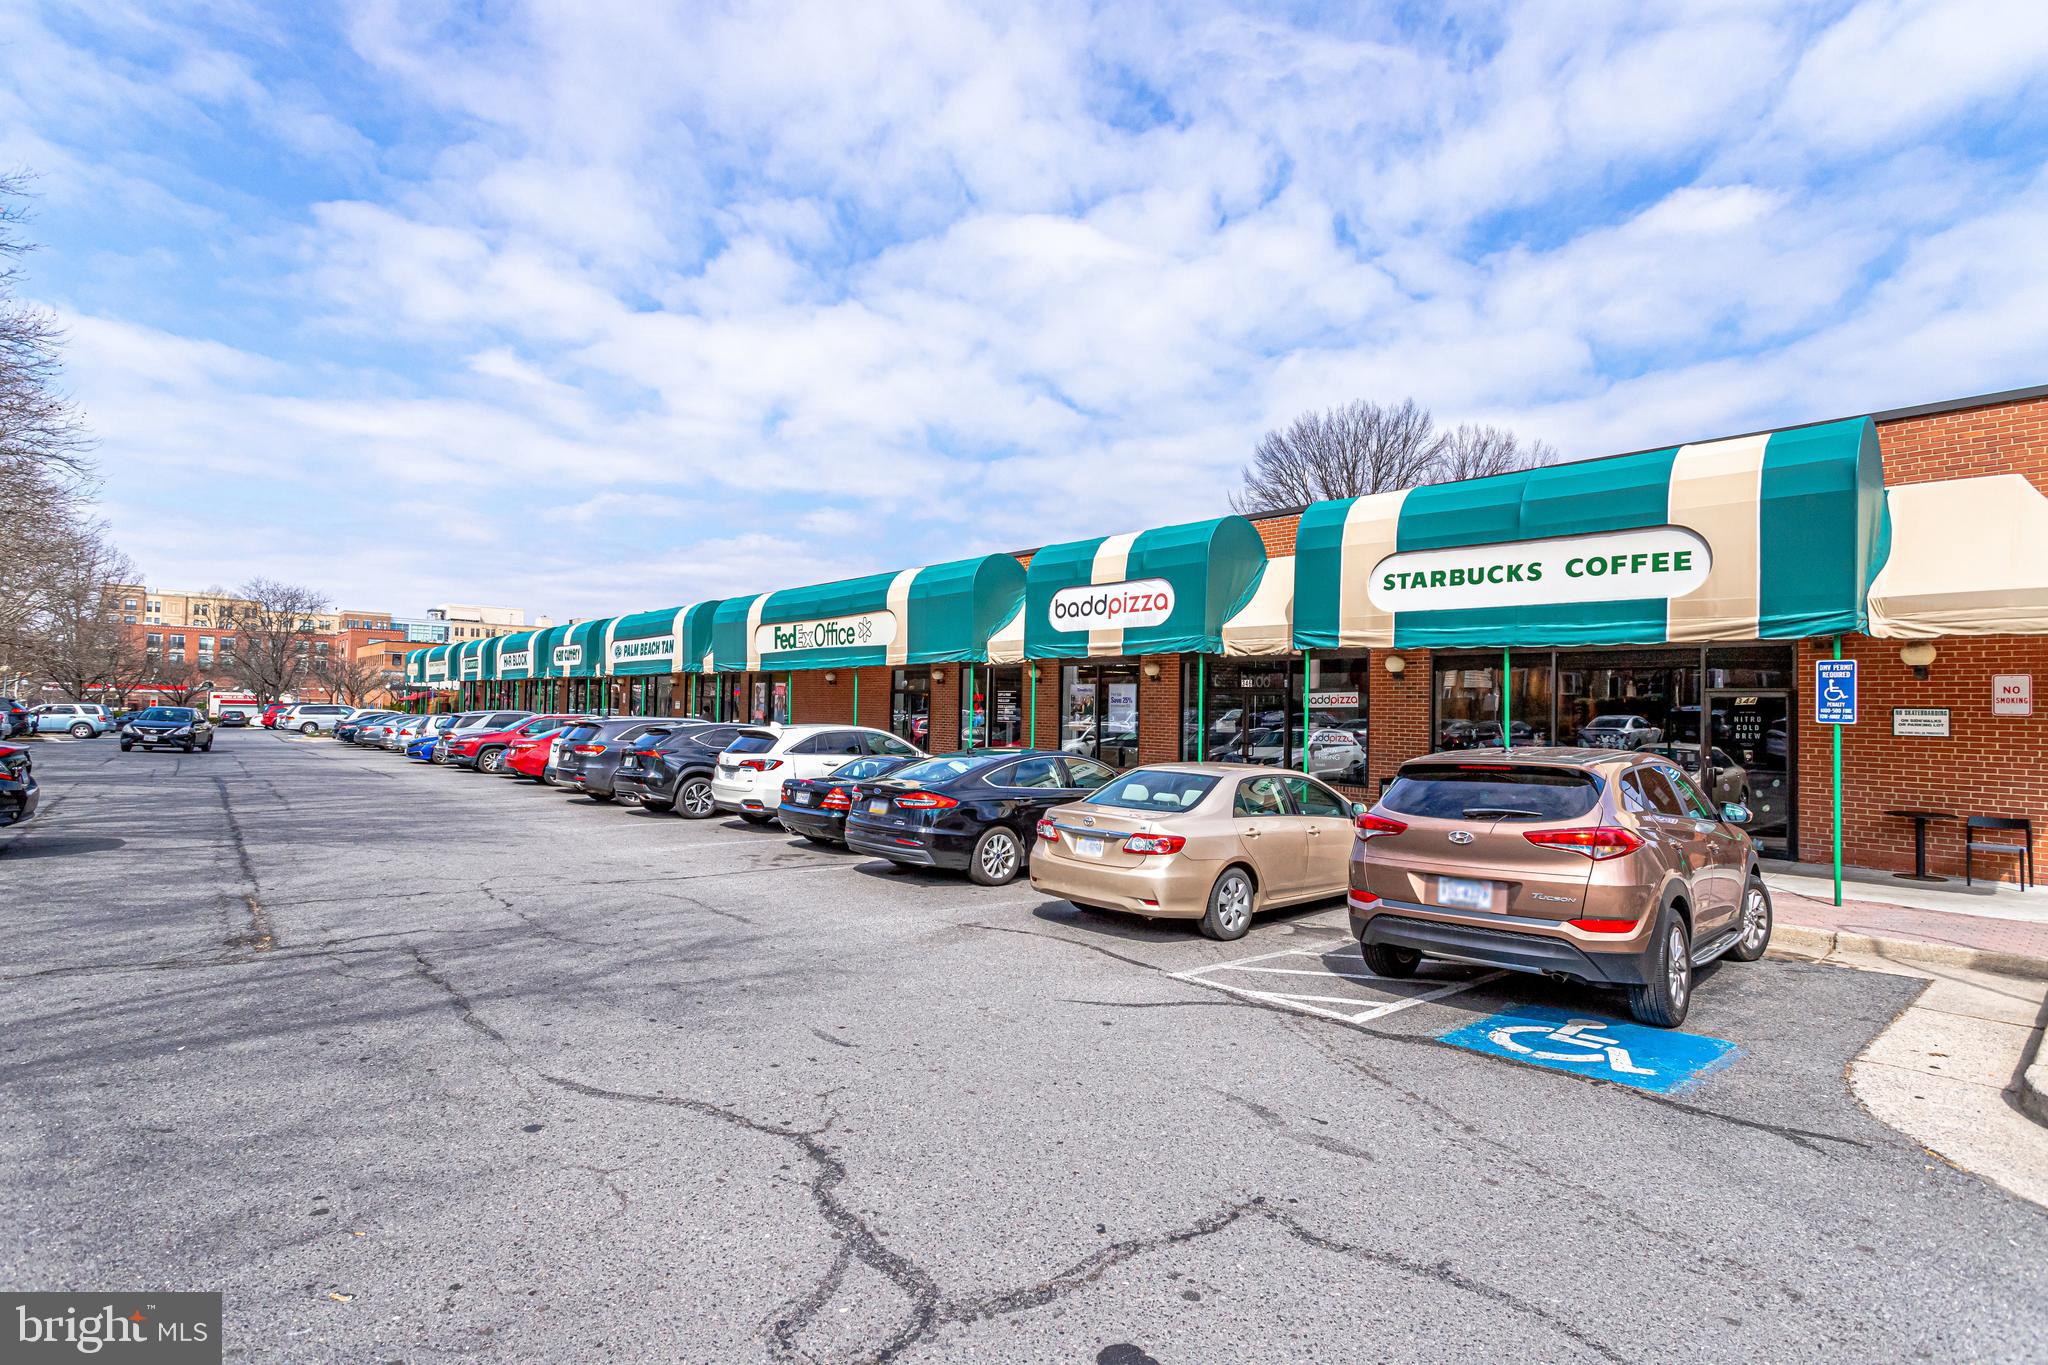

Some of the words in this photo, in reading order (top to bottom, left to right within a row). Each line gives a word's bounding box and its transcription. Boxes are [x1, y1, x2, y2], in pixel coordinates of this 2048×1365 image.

[1383, 562, 1543, 591] STARBUCKS
[1565, 551, 1692, 578] COFFEE
[624, 643, 640, 657] PALM
[640, 641, 660, 656] BEACH
[662, 639, 675, 653] TAN
[513, 653, 528, 667] BLOCK
[2003, 686, 2020, 694] NO
[1122, 696, 1133, 704] 25%
[1735, 732, 1761, 740] BREW
